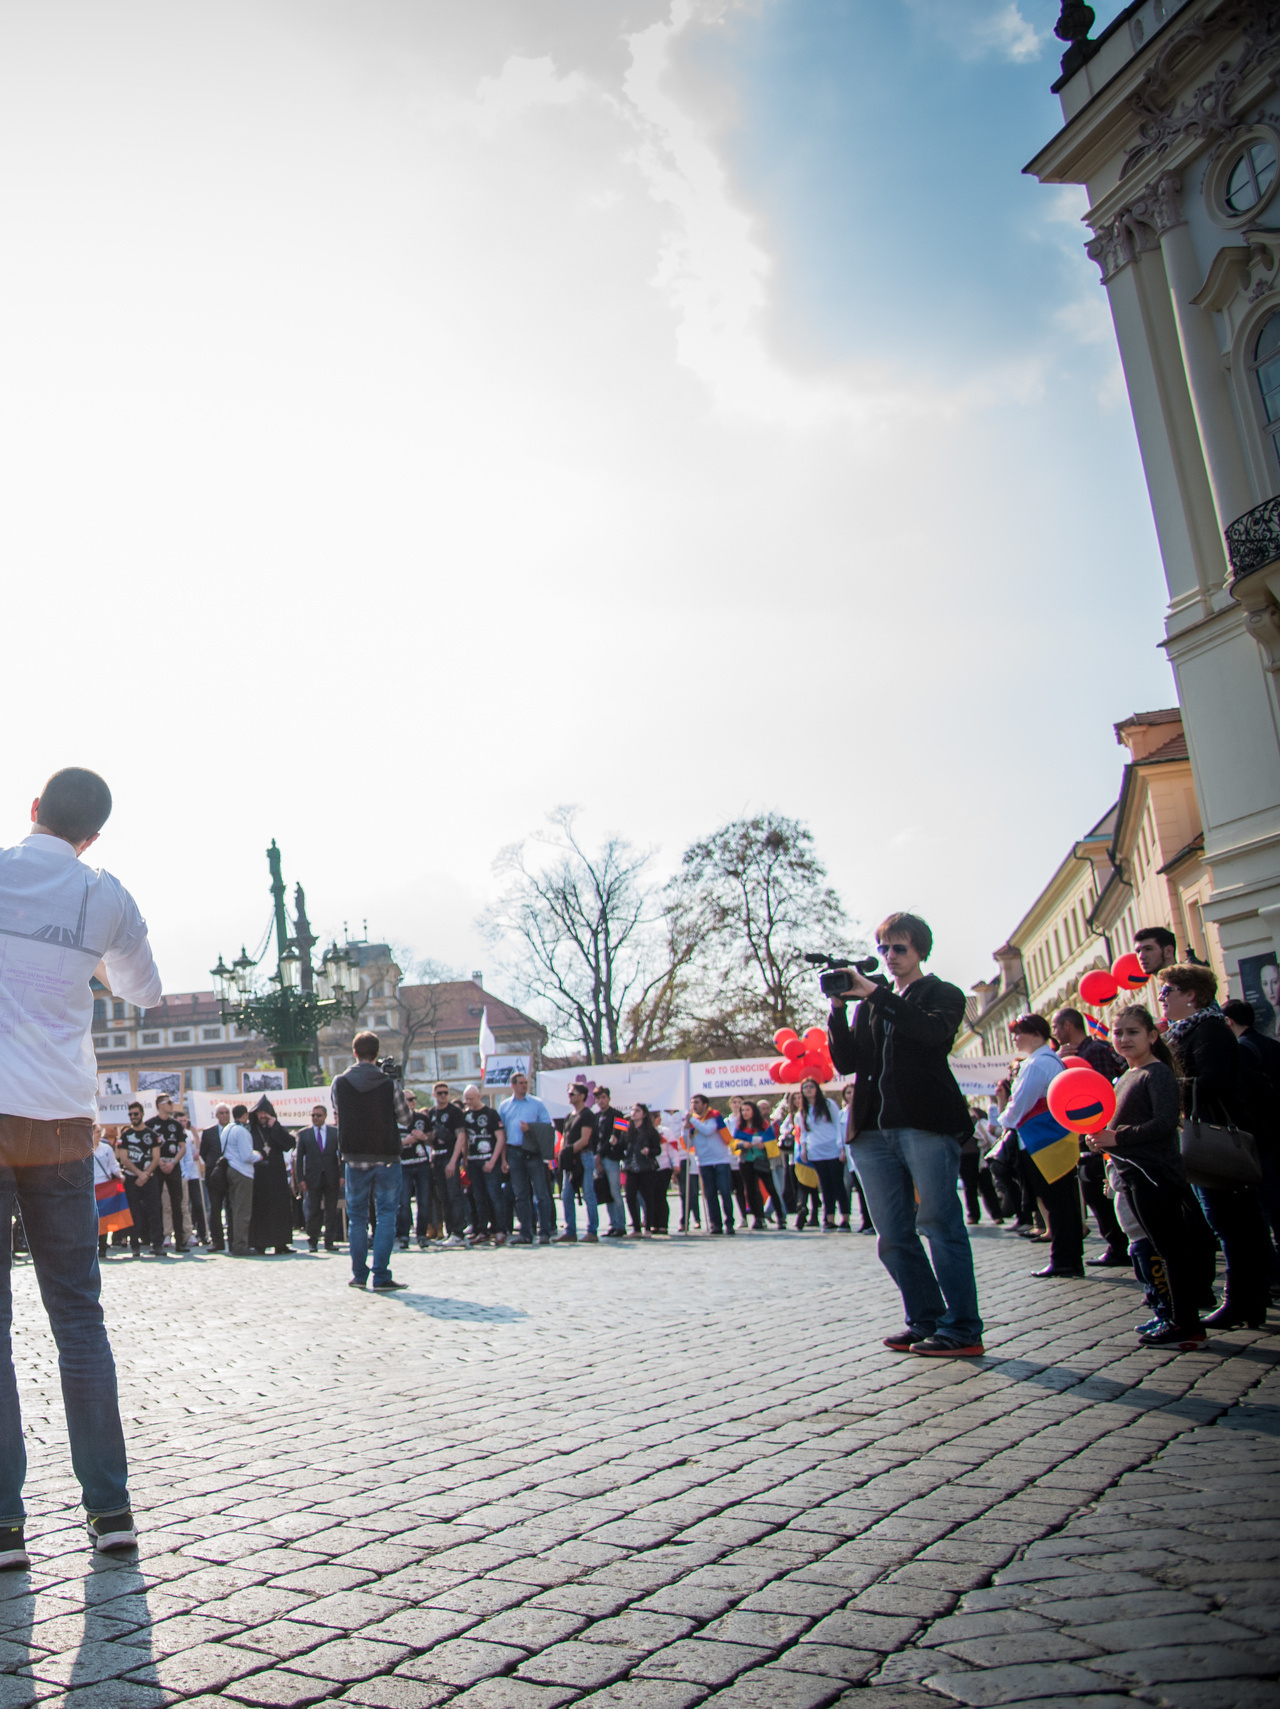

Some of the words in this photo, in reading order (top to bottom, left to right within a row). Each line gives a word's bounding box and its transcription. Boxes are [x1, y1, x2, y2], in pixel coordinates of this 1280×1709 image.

[705, 1067, 716, 1075] NO
[717, 1066, 728, 1074] TO
[702, 1081, 712, 1090] NE
